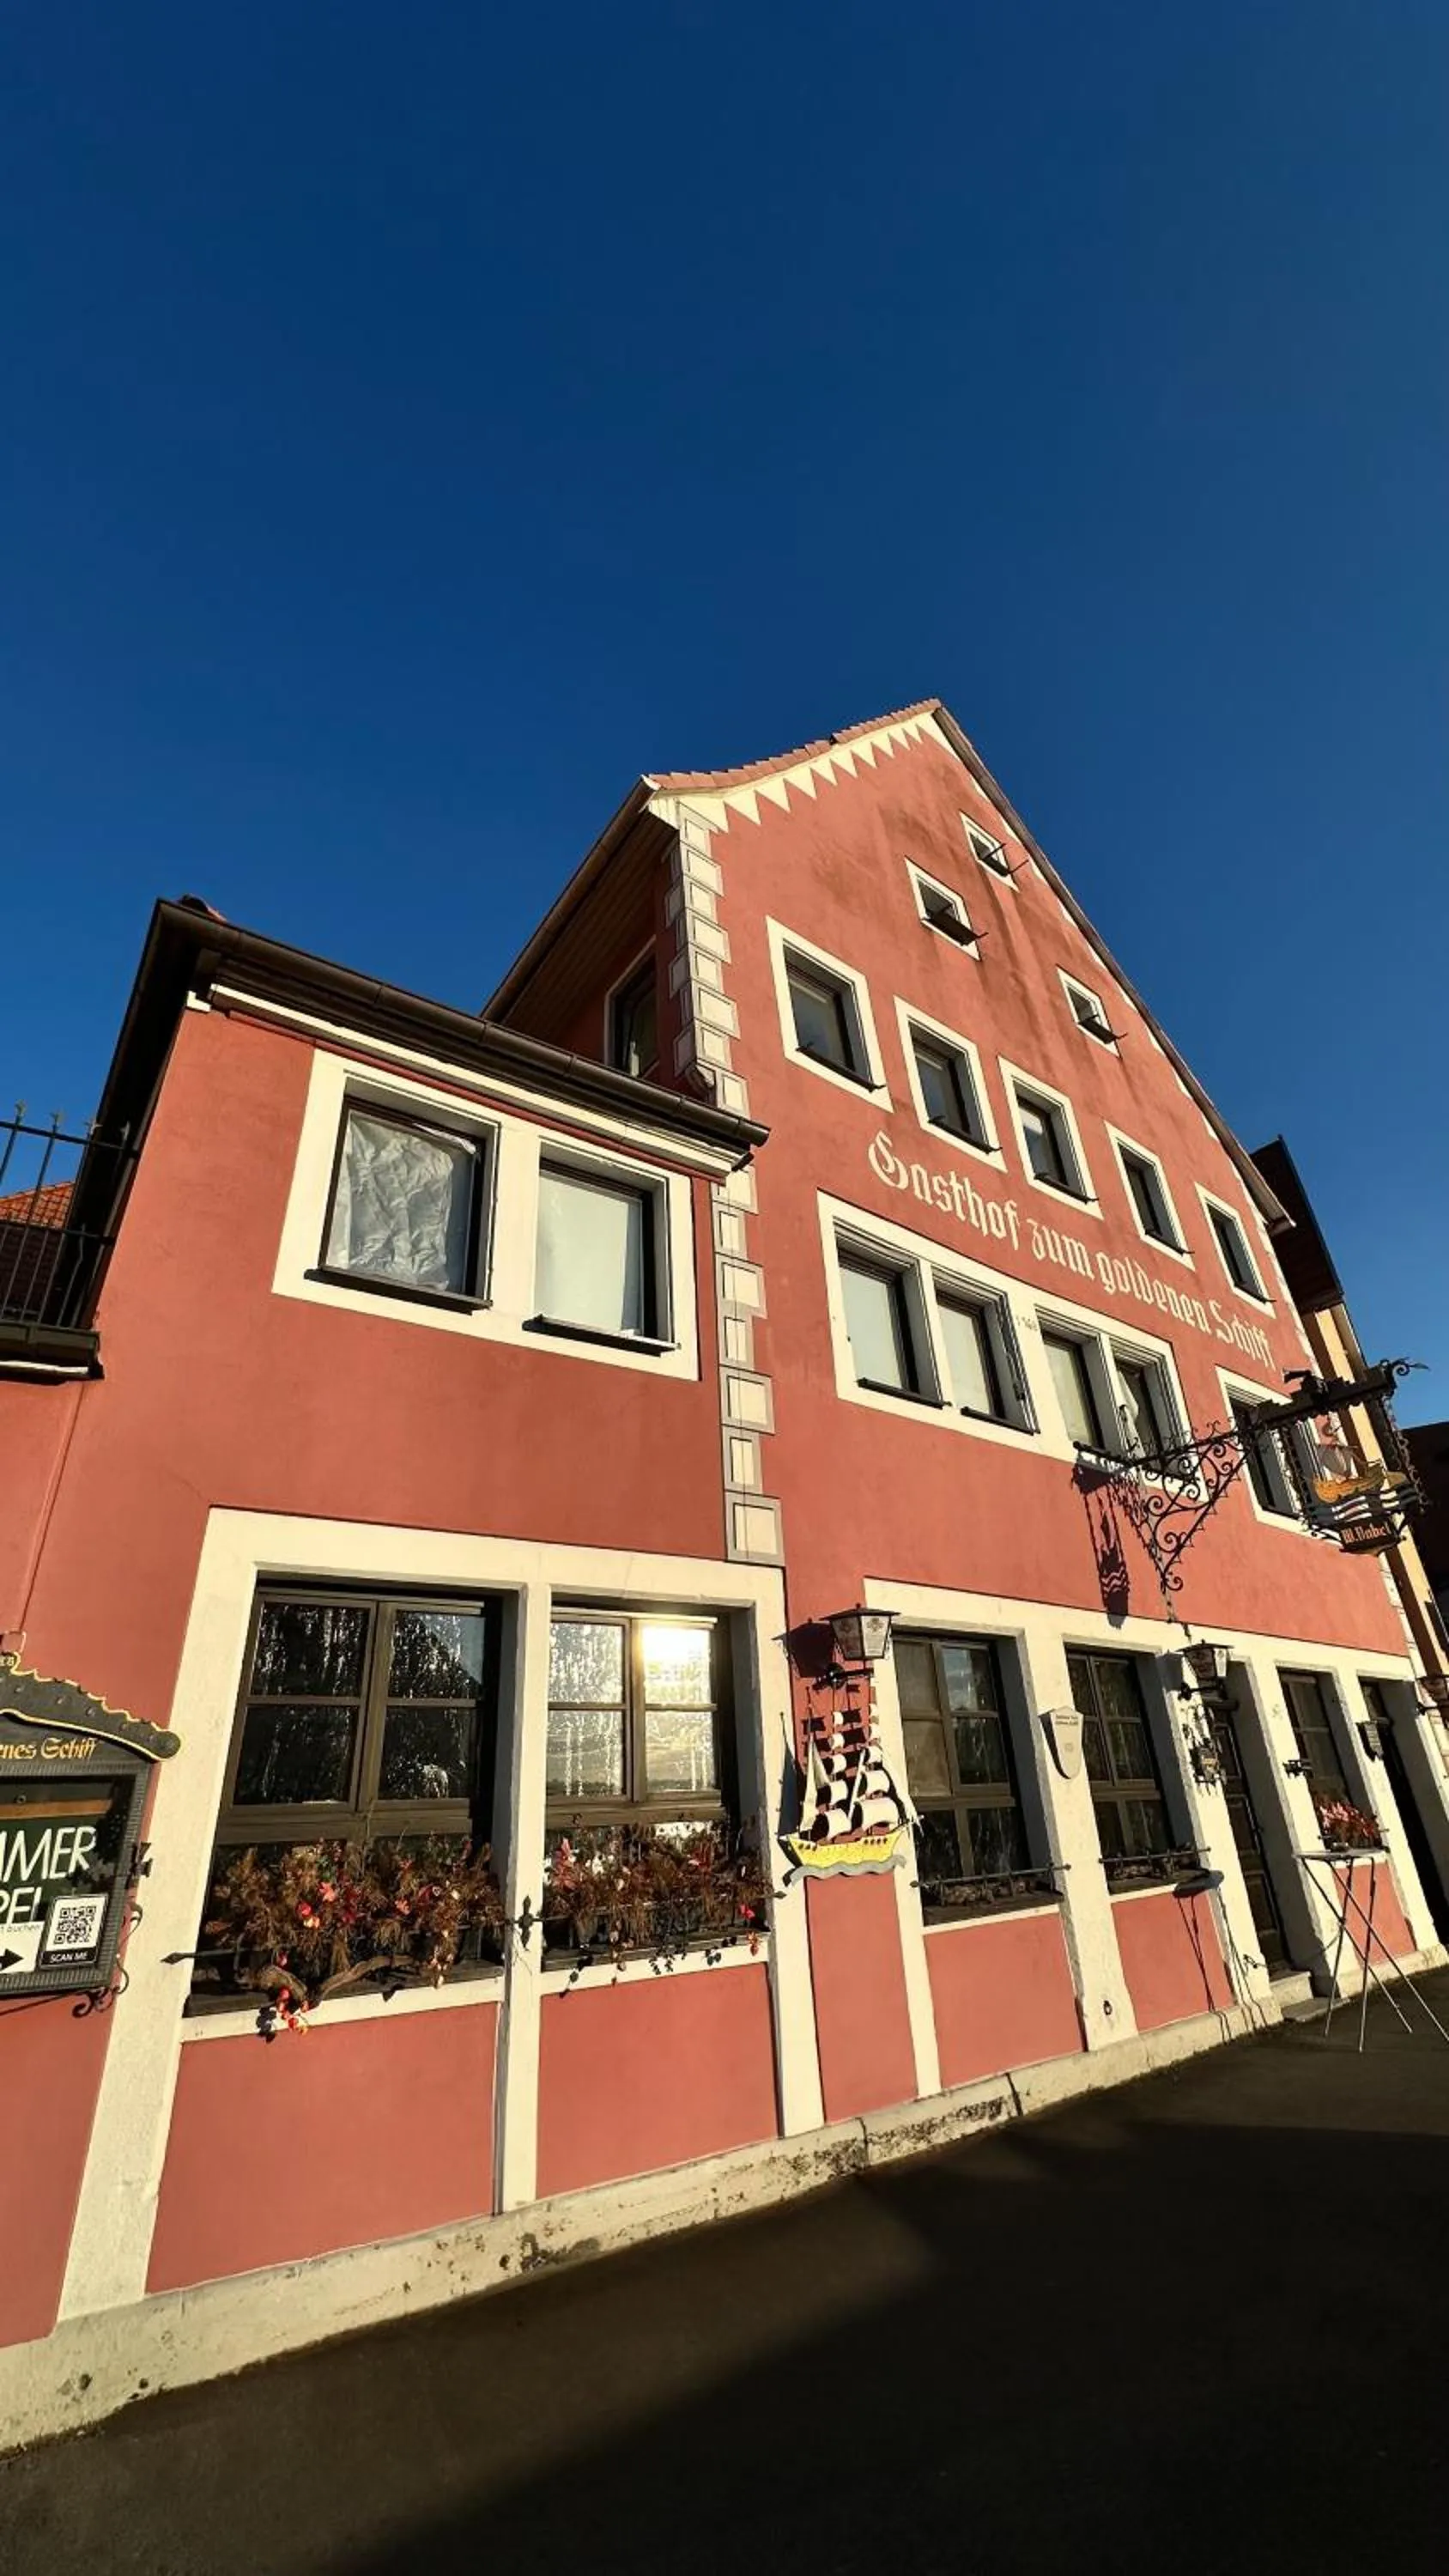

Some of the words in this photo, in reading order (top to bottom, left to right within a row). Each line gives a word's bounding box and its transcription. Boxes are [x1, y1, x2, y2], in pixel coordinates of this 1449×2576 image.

[868, 1130, 1020, 1250] Gasthof
[1028, 1218, 1095, 1281] zum
[1095, 1252, 1210, 1333] goldenen
[1210, 1299, 1276, 1371] Schiff
[40, 1737, 97, 1761] Schiff
[0, 1826, 96, 1882] MER
[50, 1952, 73, 1964] SCAN
